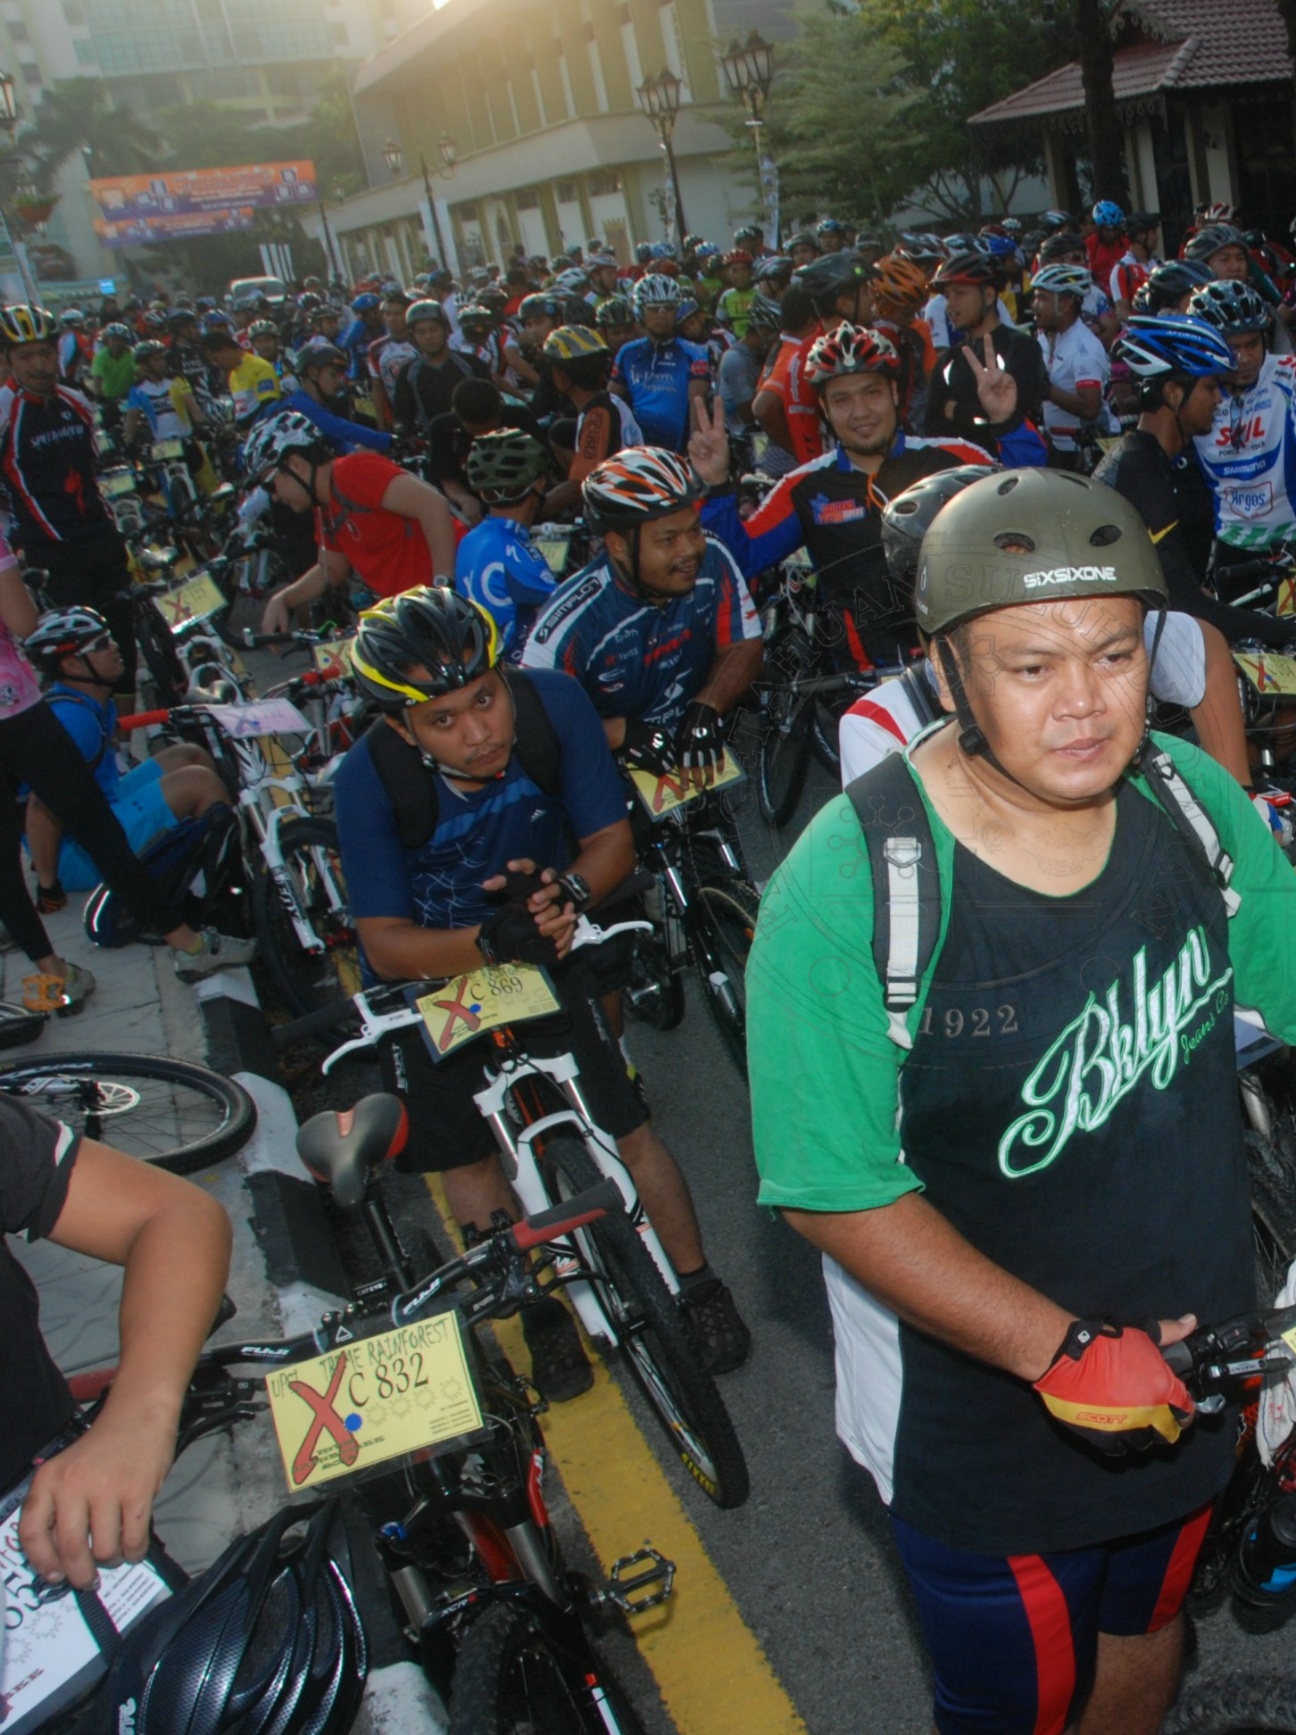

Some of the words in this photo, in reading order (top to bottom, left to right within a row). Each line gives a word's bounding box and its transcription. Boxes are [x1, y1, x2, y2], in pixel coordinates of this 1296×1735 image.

[1216, 415, 1265, 449] SKIL
[1223, 457, 1266, 476] SHIMANO
[1230, 488, 1266, 512] Argos
[1023, 566, 1117, 589] SIXSIXONE
[470, 982, 485, 1002] C
[488, 975, 524, 997] 869
[998, 925, 1234, 1179] Bklyn
[403, 1277, 441, 1316] FUJI
[241, 1345, 292, 1358] FUJI
[367, 1317, 450, 1366] RAINFOREST
[349, 1371, 370, 1408] C
[375, 1351, 430, 1400] 832
